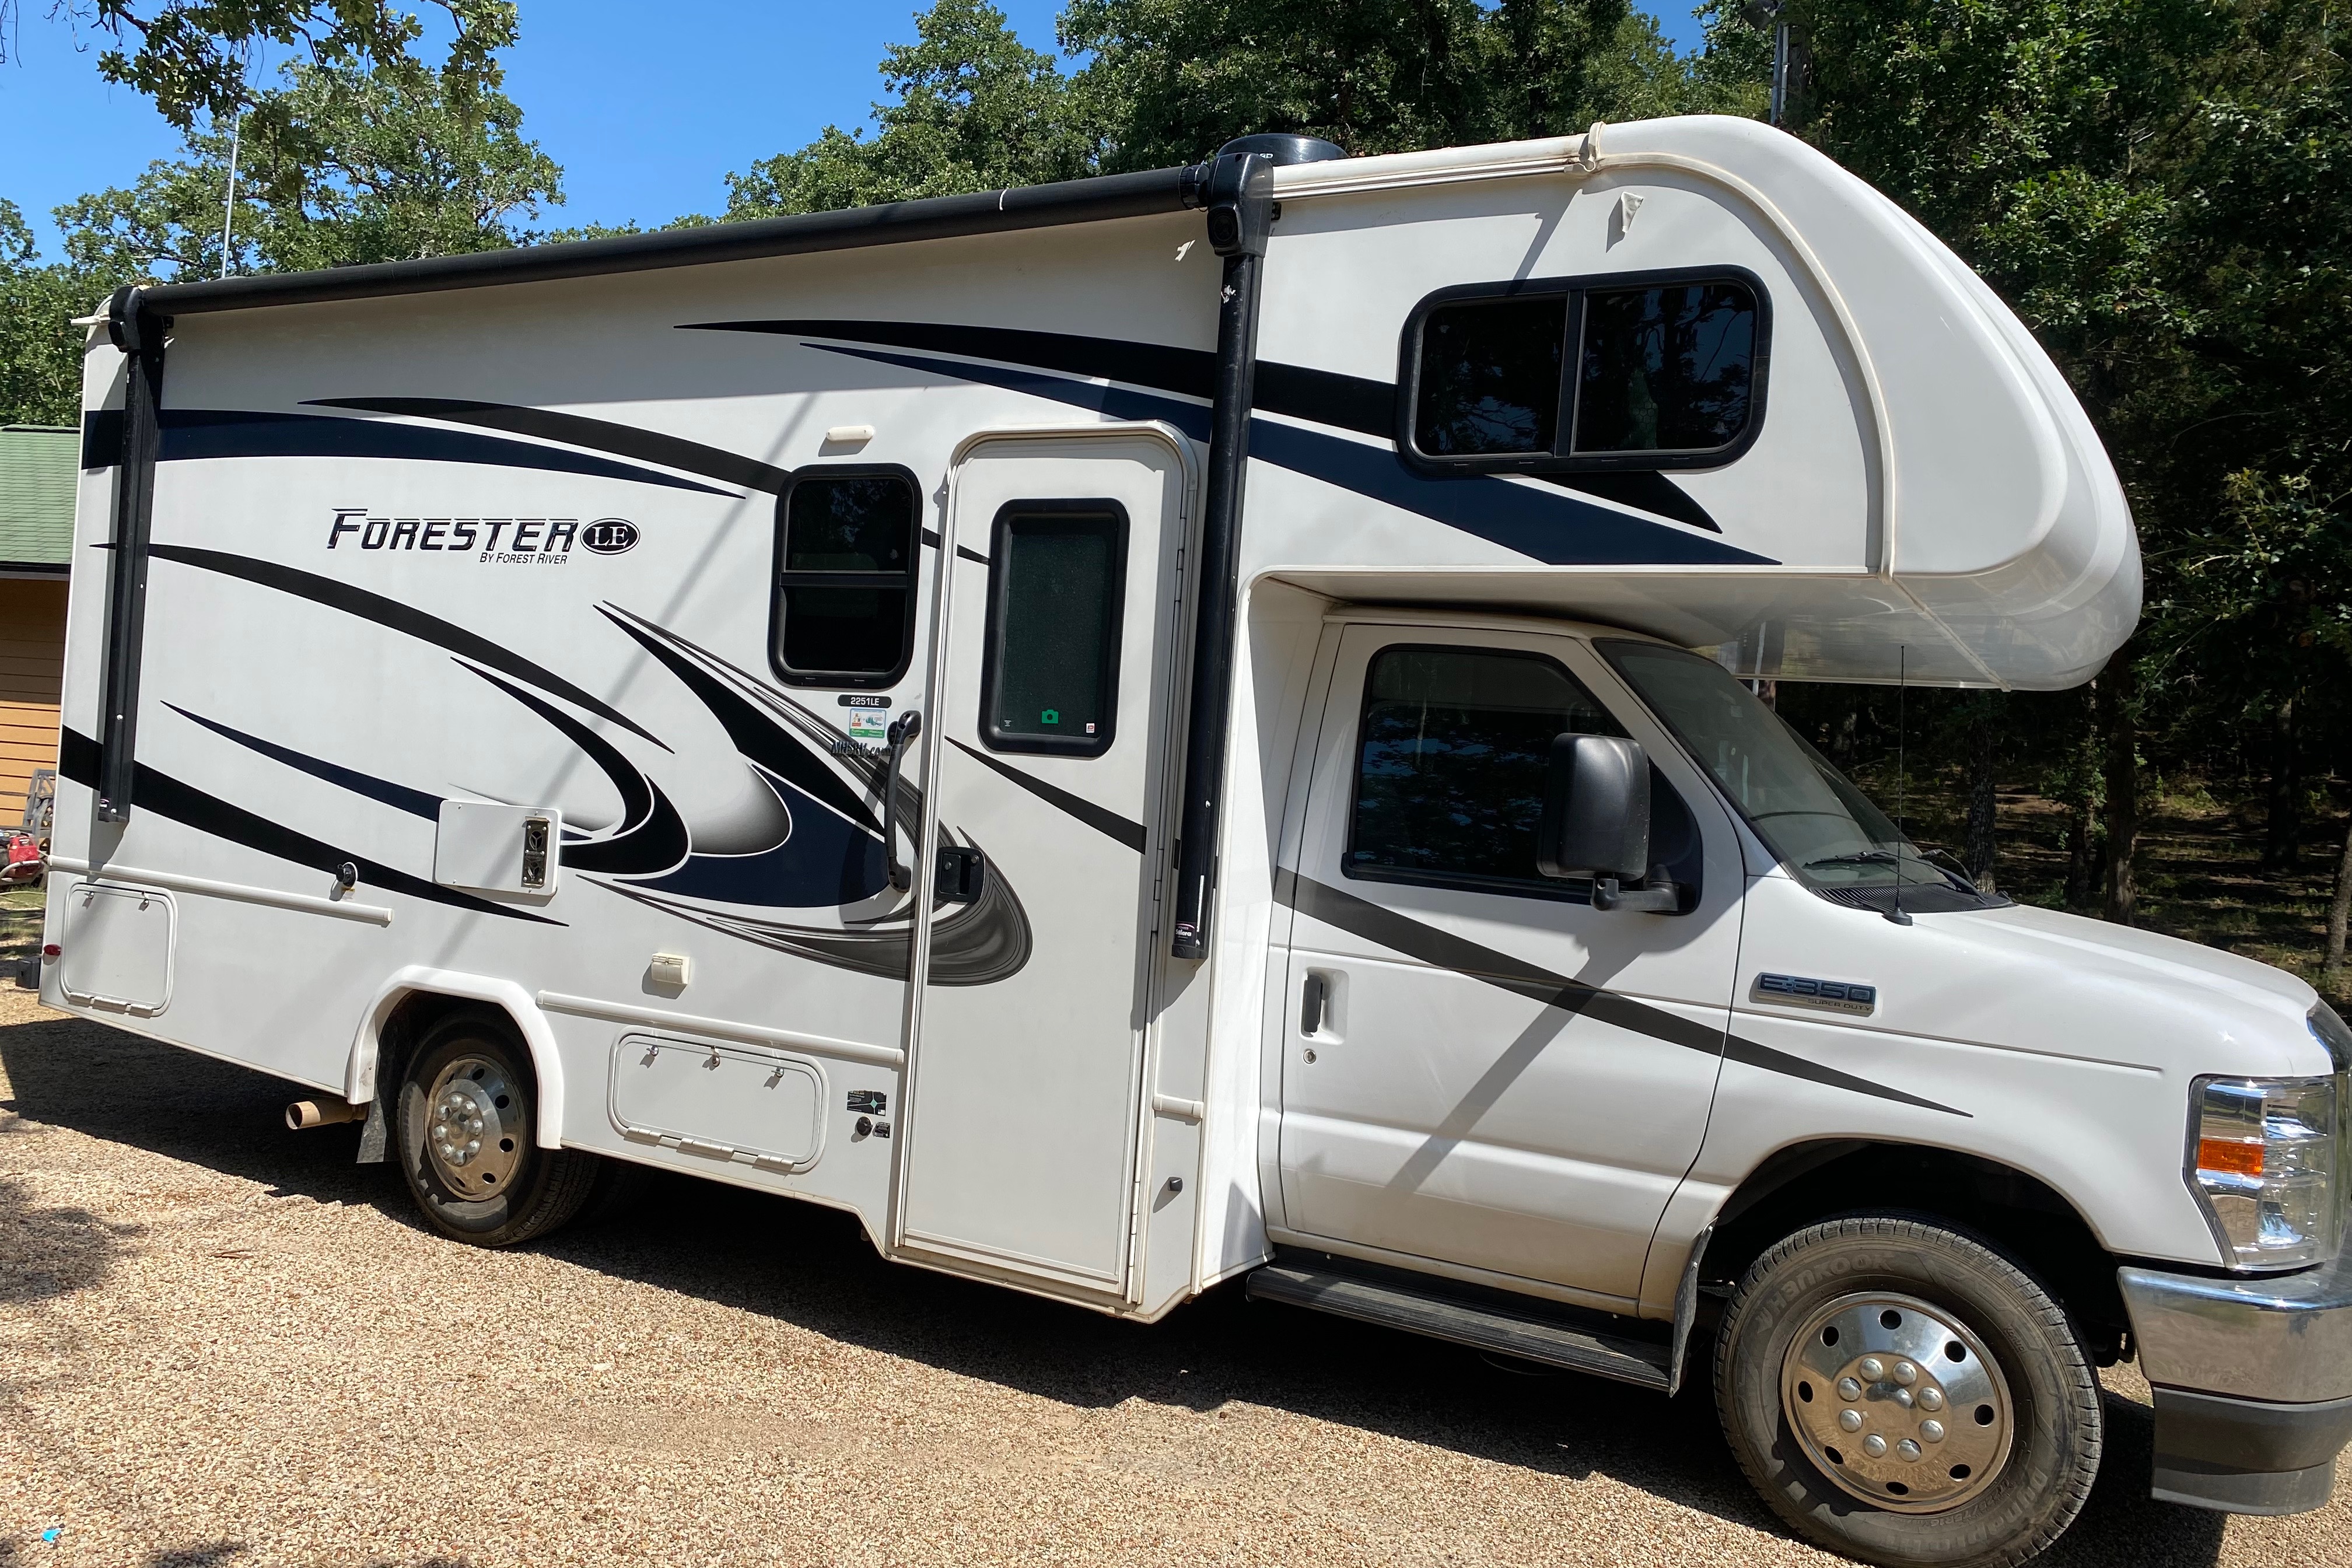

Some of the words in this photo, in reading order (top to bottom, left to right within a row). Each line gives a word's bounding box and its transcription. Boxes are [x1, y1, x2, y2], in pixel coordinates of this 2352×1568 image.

[327, 508, 579, 552] FORESTER
[589, 524, 631, 548] LE
[480, 552, 495, 563] BY
[496, 552, 536, 564] FOREST
[537, 553, 568, 564] RIVER
[850, 696, 880, 706] 2251LE
[1175, 929, 1192, 937] Solera
[1759, 974, 1876, 1003] E-350
[1808, 998, 1841, 1008] SUPER
[1843, 1003, 1873, 1012] DUTY
